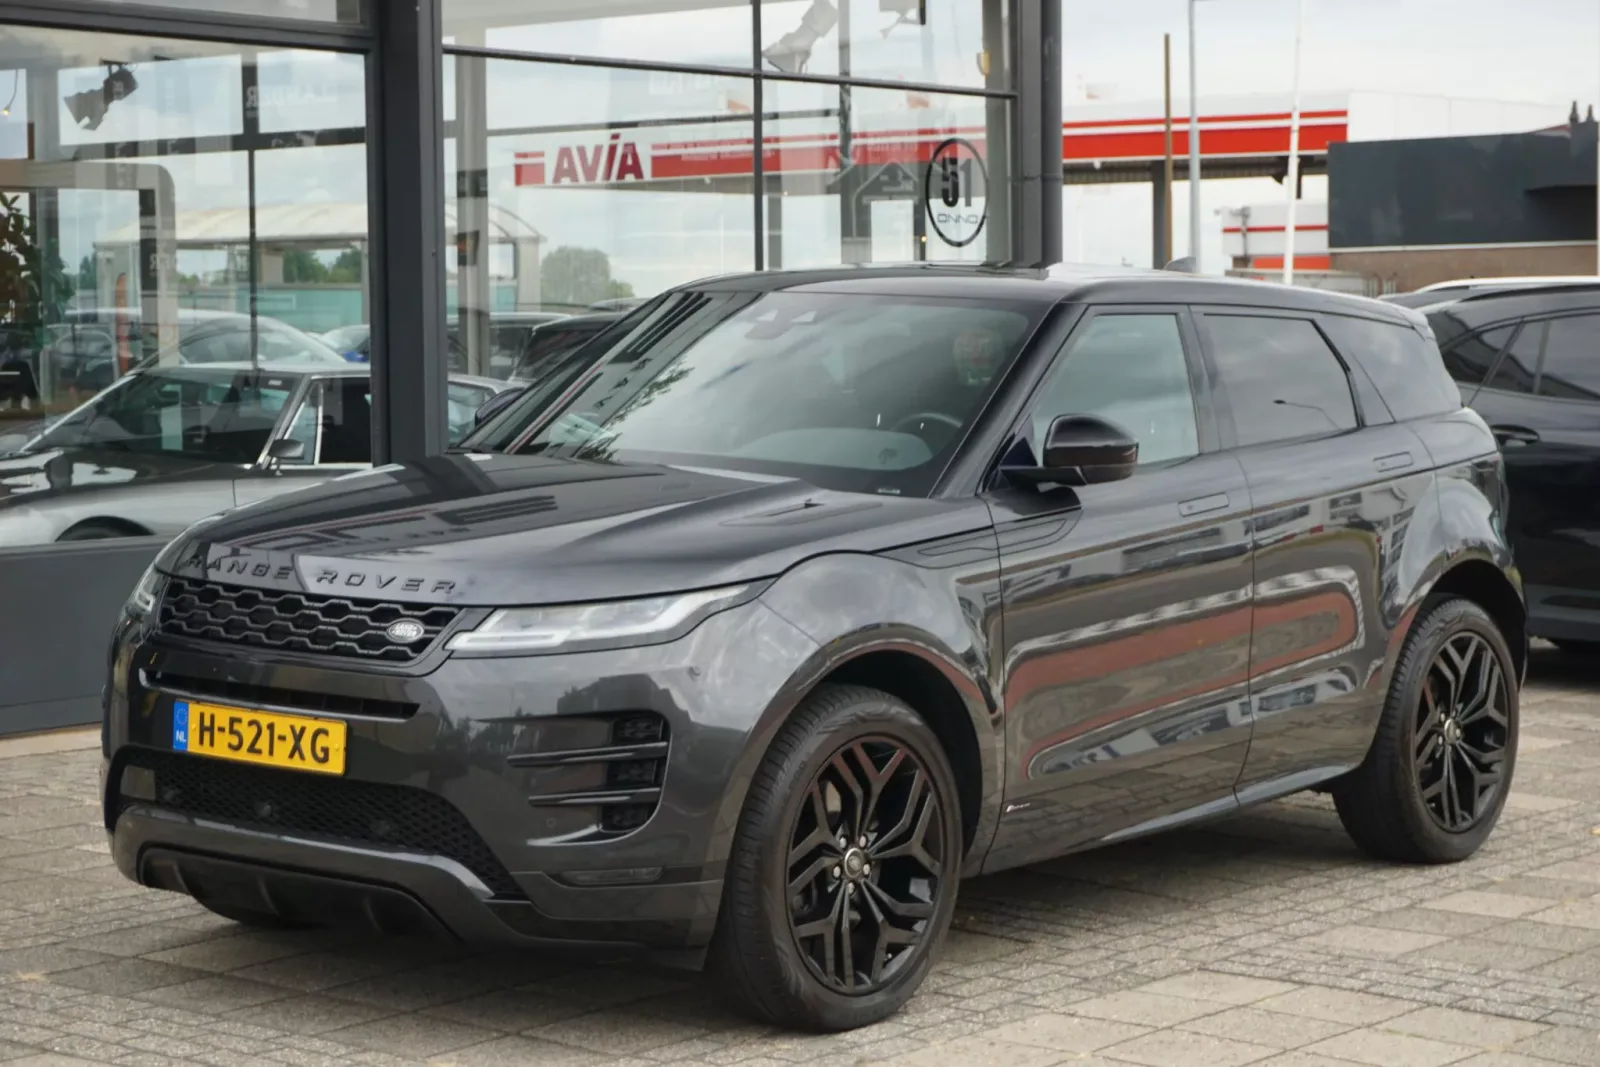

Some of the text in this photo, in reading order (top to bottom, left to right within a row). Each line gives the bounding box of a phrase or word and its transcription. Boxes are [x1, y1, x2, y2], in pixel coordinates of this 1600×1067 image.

[941, 156, 972, 207] 51
[187, 554, 456, 594] RANGE ROVER
[175, 729, 187, 743] NL
[198, 711, 331, 764] H-521-XG
